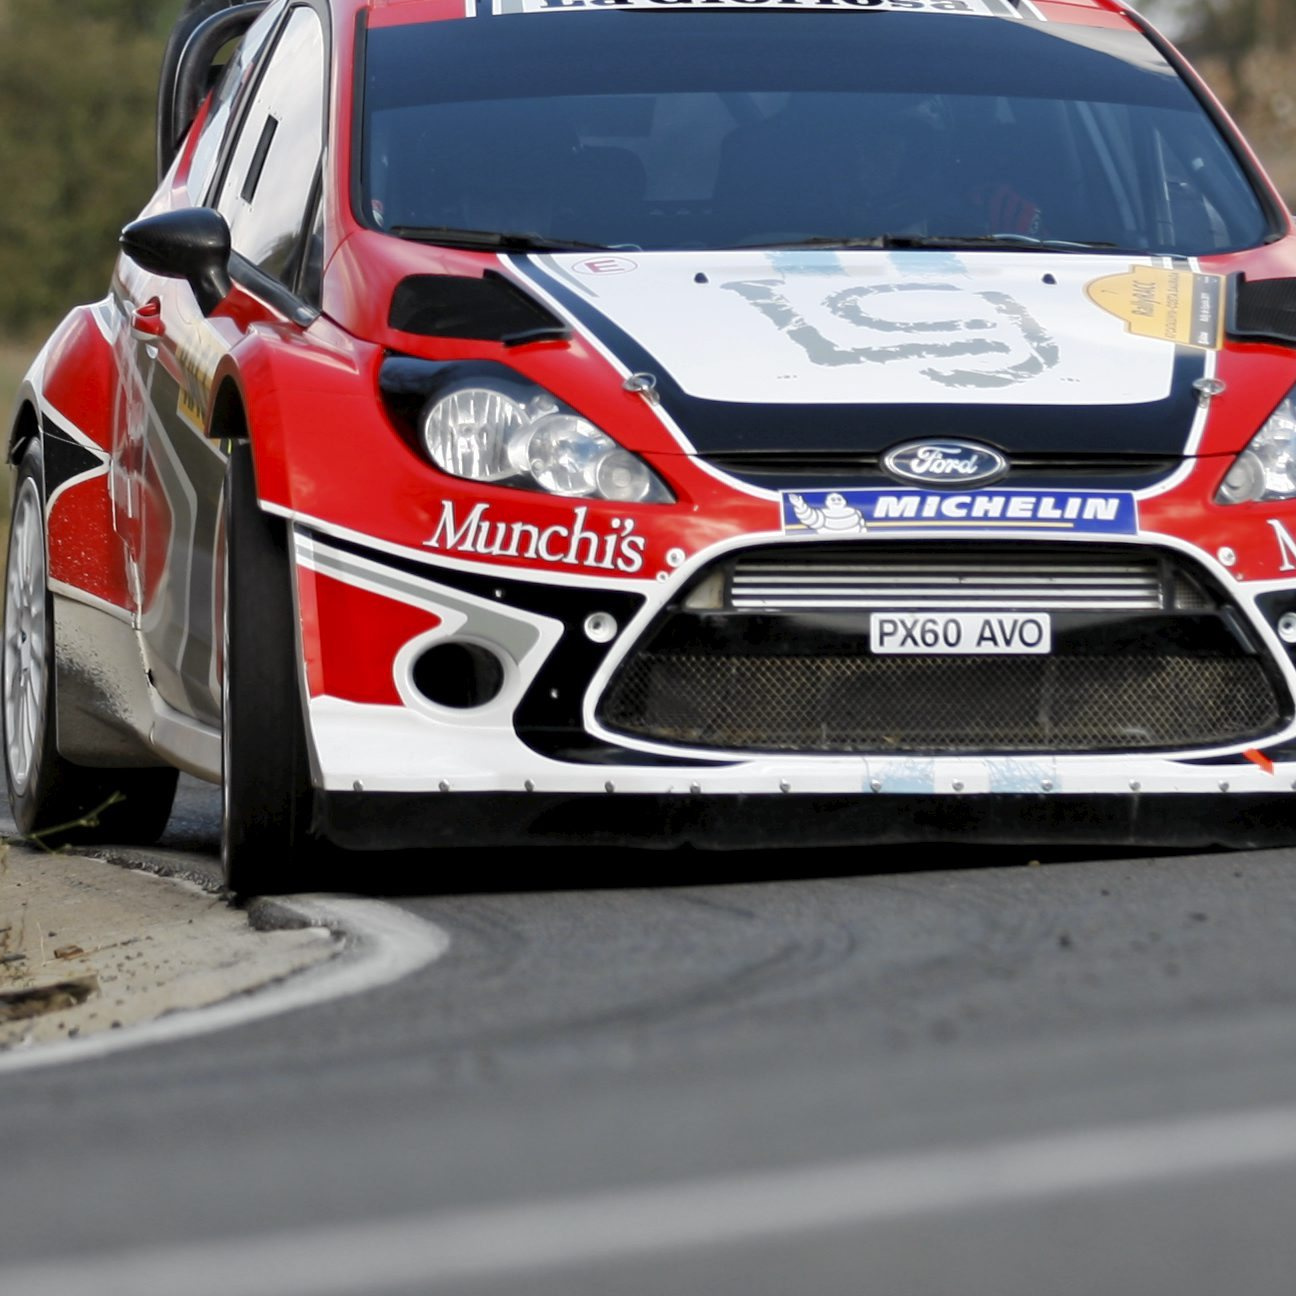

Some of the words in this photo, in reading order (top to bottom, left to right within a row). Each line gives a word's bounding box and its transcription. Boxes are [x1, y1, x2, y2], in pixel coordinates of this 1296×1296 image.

[584, 259, 625, 273] E
[910, 446, 978, 474] Ford
[872, 495, 1120, 520] MICHELIN
[422, 500, 645, 572] Munchi's
[878, 618, 962, 648] PX60
[975, 618, 1044, 648] AVO
